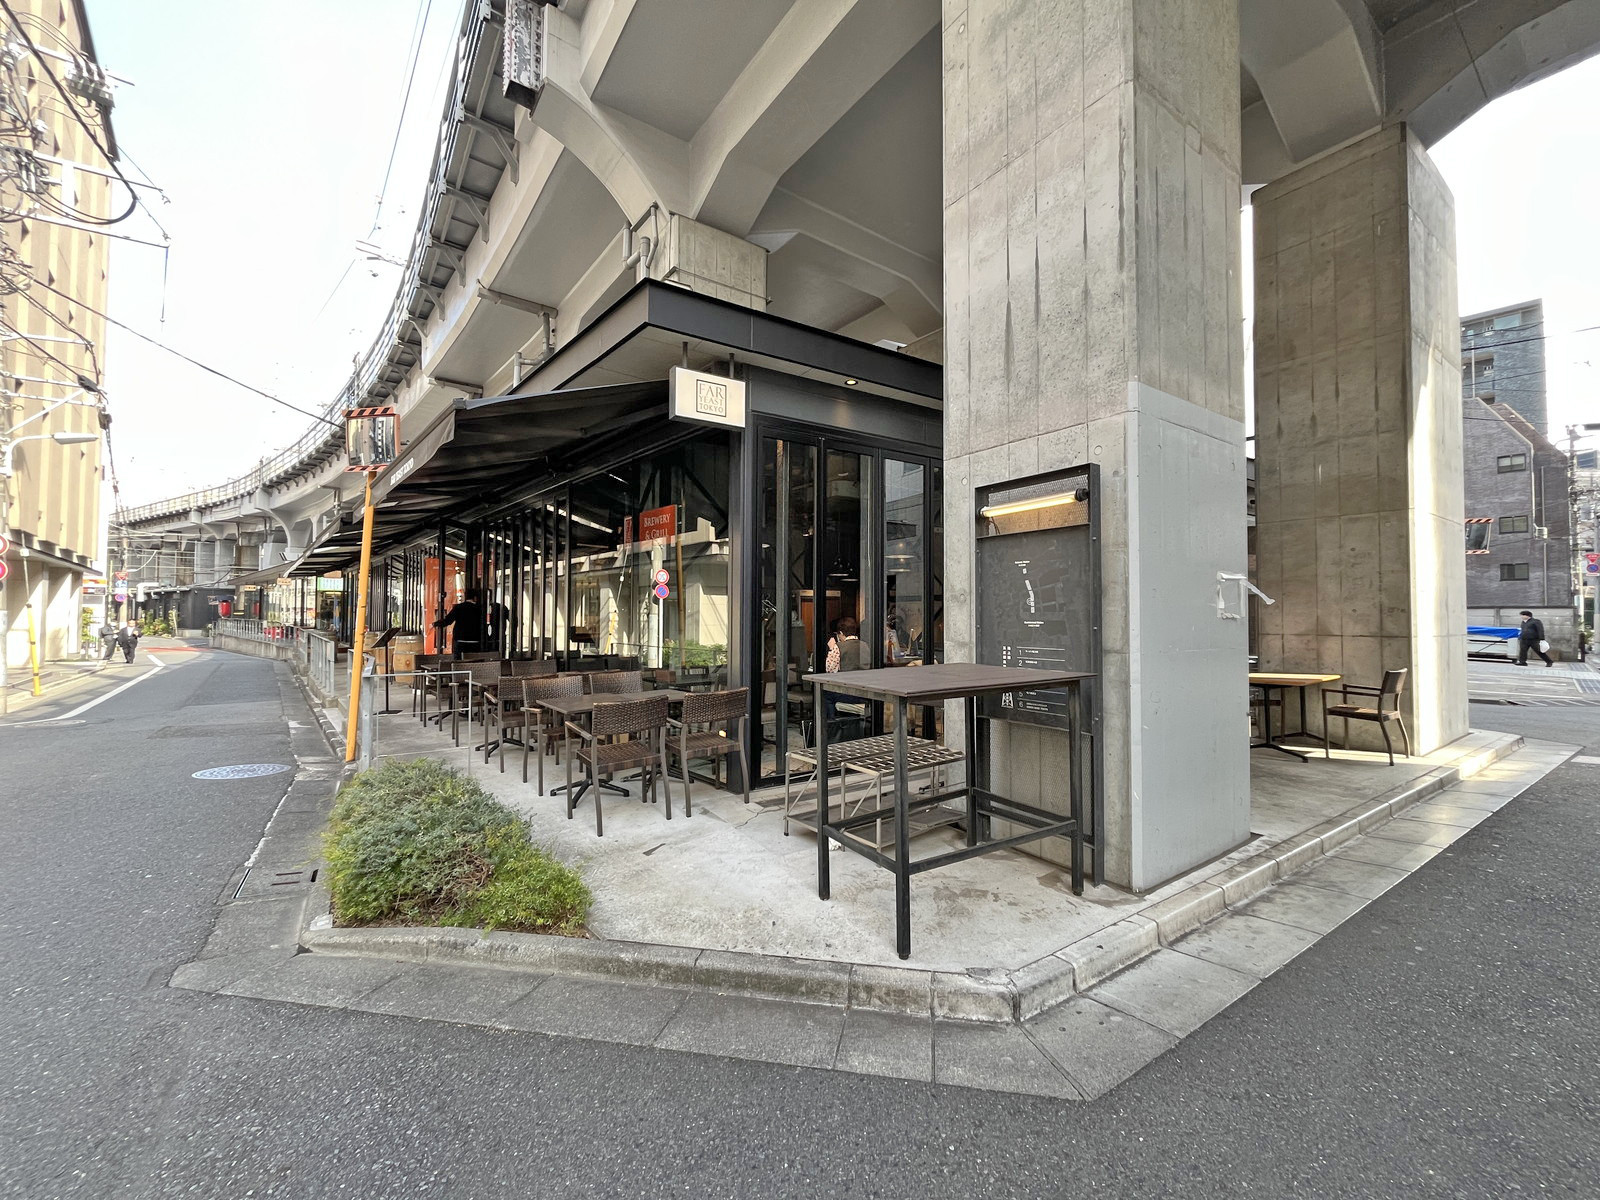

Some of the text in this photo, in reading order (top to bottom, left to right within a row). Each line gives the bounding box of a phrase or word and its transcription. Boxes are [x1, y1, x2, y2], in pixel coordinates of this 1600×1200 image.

[699, 383, 724, 399] FAR
[699, 395, 723, 406] YEAST
[699, 403, 723, 413] TOKYO
[644, 514, 670, 527] BREWERY
[645, 528, 668, 540] & GRILL
